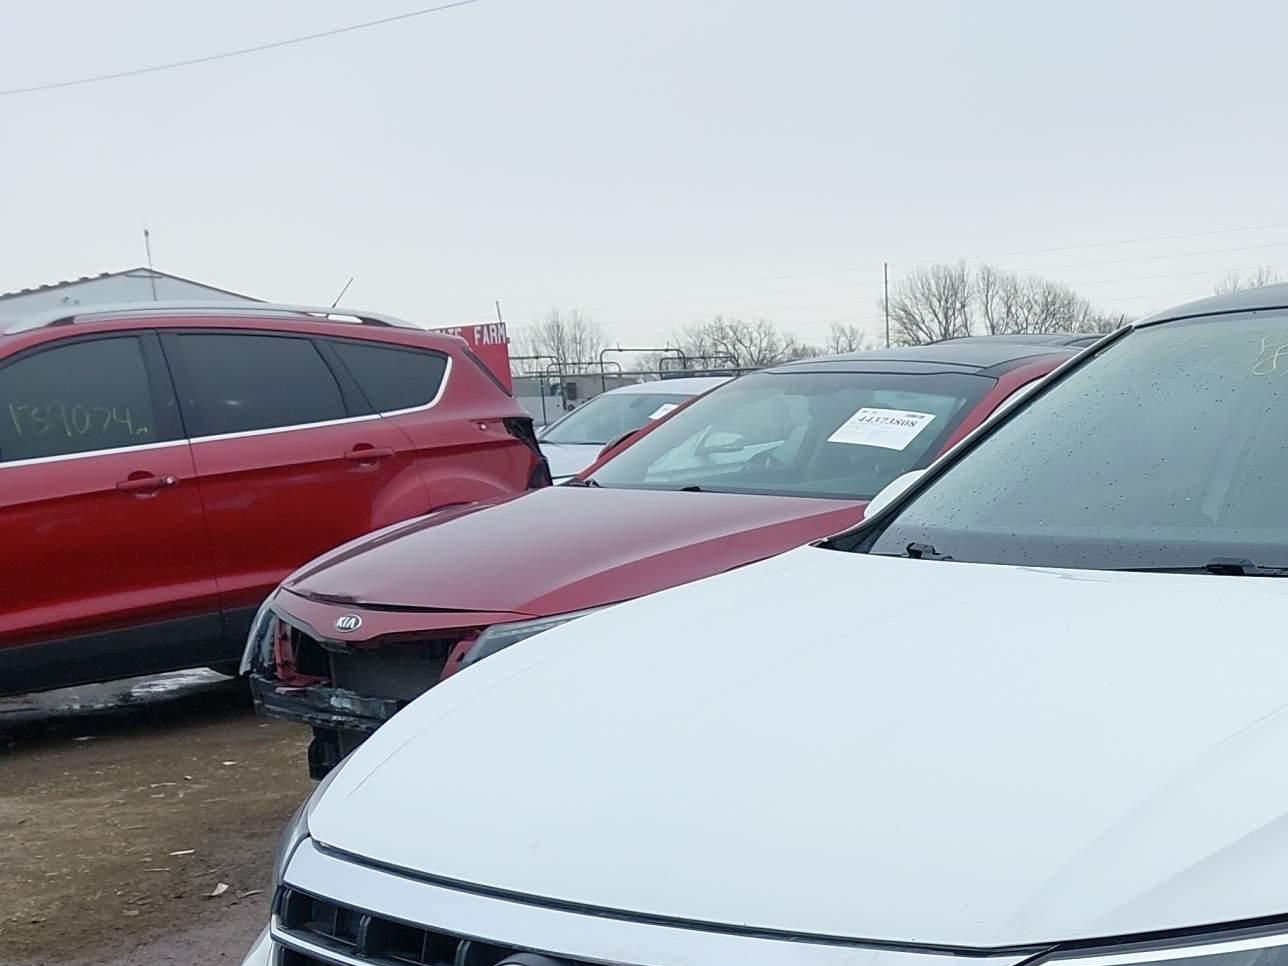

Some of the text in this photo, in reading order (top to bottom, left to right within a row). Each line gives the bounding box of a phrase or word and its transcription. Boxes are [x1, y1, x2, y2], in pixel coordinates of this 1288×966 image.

[473, 324, 507, 346] FARM
[857, 414, 918, 428] 44373808
[336, 616, 357, 628] KIA
